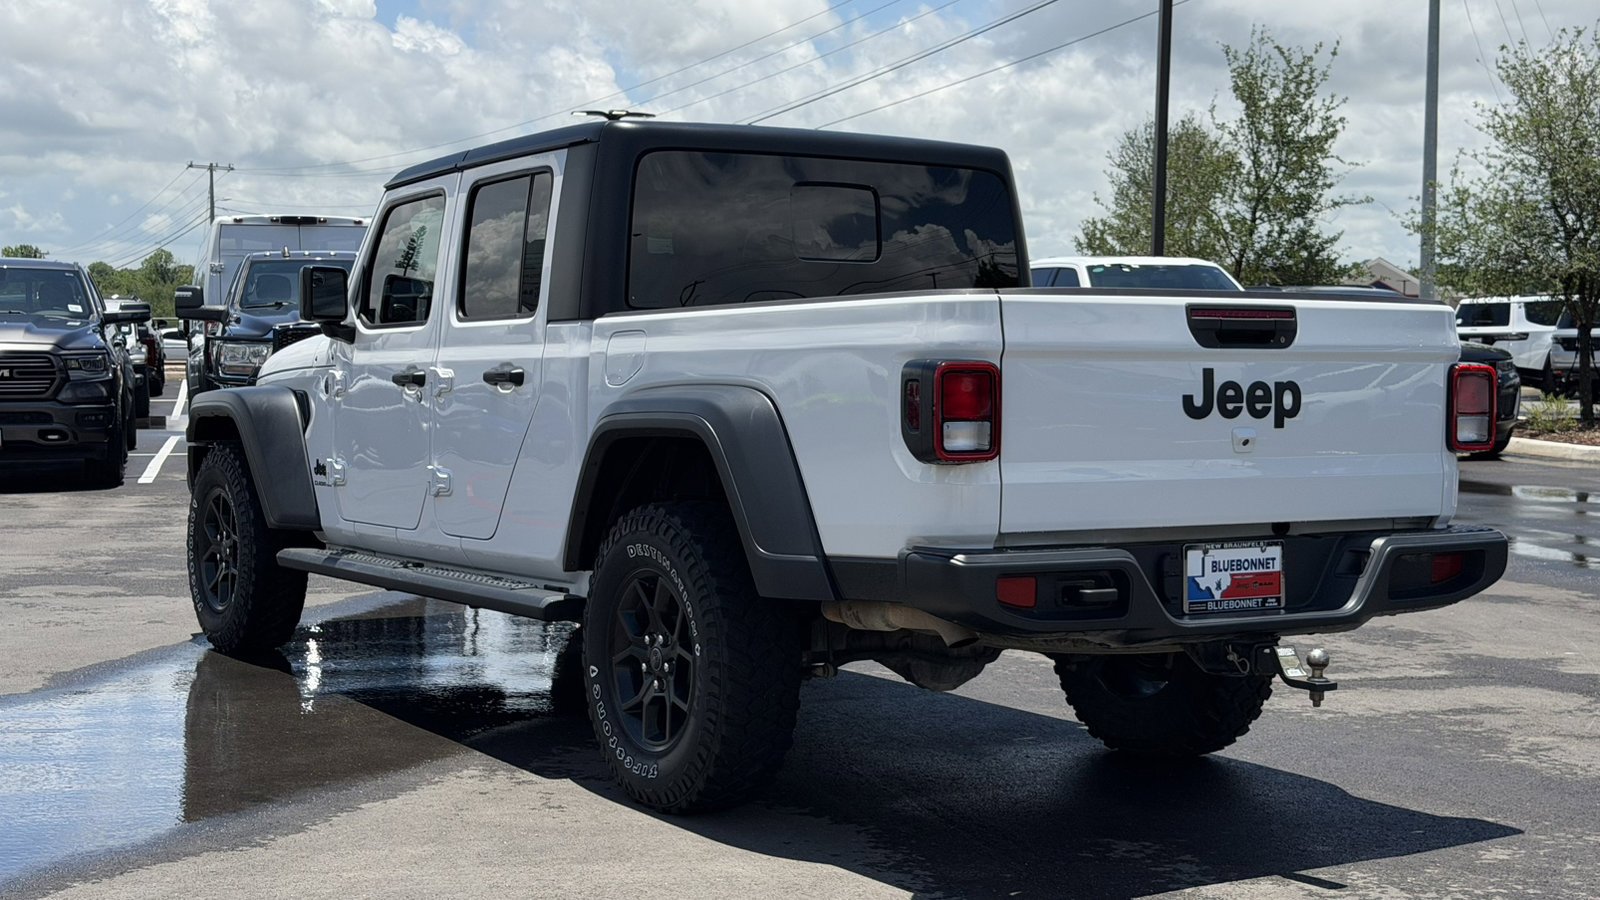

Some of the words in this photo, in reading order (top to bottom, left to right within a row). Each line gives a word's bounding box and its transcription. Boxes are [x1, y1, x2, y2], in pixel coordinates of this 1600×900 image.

[1182, 367, 1302, 429] Jeep
[1223, 541, 1264, 549] BRAUNFELS
[1211, 558, 1276, 573] BLUEBONNET
[627, 544, 698, 636] DESTINATION
[1208, 598, 1262, 610] BLUEBONNET
